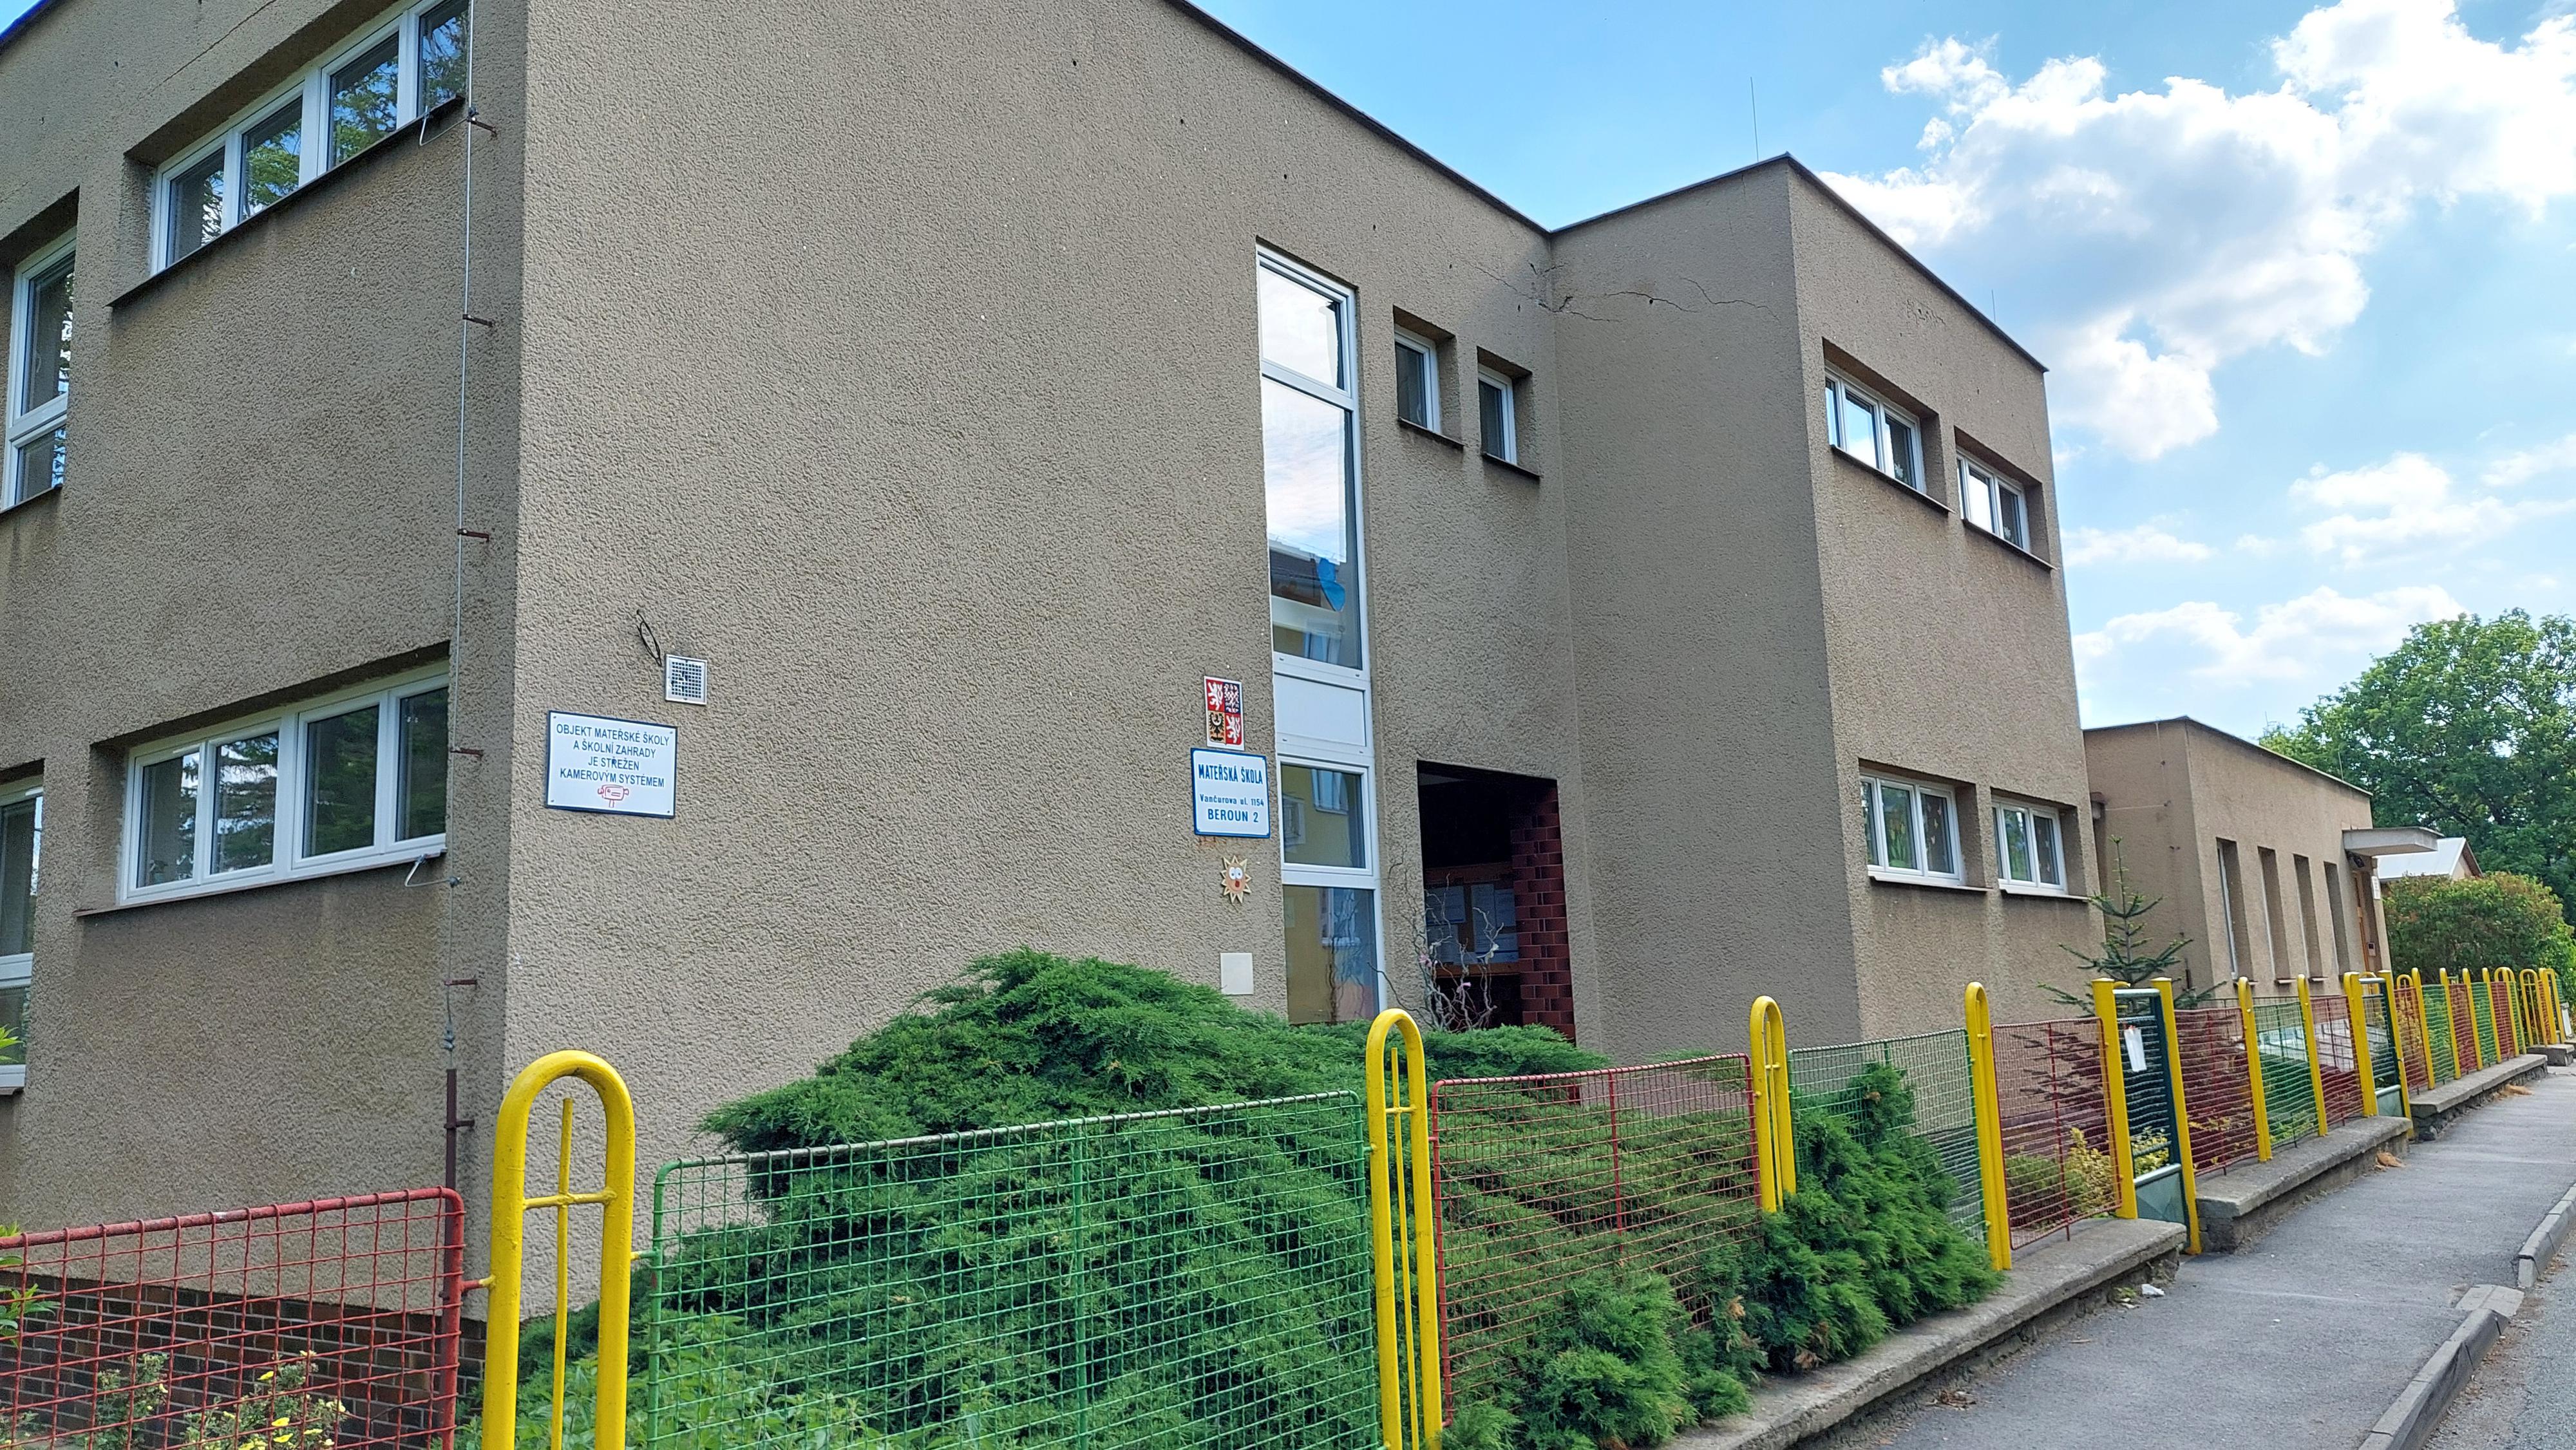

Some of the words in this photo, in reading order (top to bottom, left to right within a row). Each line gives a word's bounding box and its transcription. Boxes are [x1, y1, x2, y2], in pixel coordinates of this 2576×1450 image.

[556, 724, 592, 737] OBJEKT
[594, 728, 640, 742] MATEŘSKÉ
[643, 731, 670, 746] ŠKOLY
[573, 740, 580, 750] A
[582, 739, 614, 754] ŠKOLNÍ
[616, 745, 656, 758] ZAHRADY
[588, 757, 598, 766] JE
[601, 756, 639, 771] STŘEŽEN
[560, 767, 616, 783] KAMEROVÝM
[619, 774, 665, 787] SYSTÉMEM
[1198, 764, 1238, 782] MATEŘSKÁ
[1241, 766, 1263, 785] ŠKOLA
[1200, 794, 1236, 805] Vančurova
[1208, 809, 1248, 822] BEROUN
[1253, 812, 1259, 823] 2
